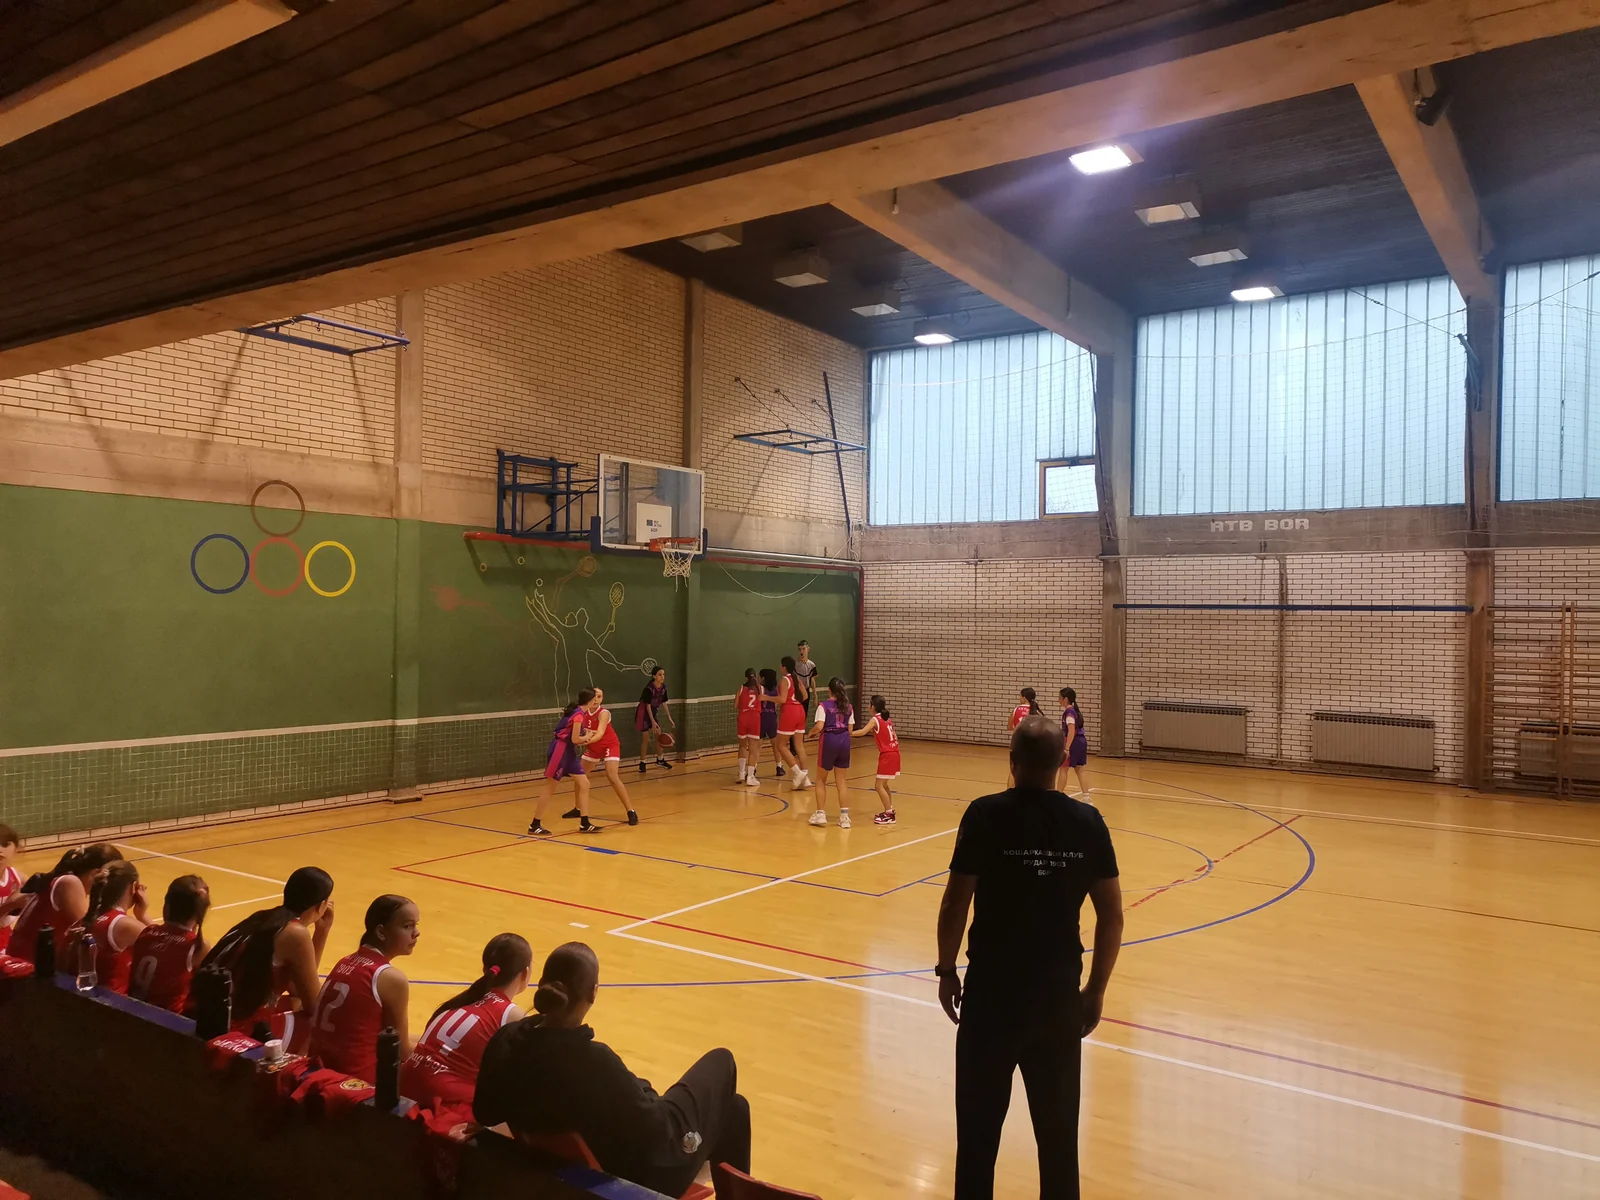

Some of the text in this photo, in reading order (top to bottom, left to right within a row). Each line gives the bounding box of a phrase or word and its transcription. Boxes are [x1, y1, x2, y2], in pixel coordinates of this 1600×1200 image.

[1264, 518, 1310, 531] BOR
[748, 694, 757, 708] 2
[1062, 851, 1084, 859] КЛУБ
[1049, 860, 1067, 868] 1903
[309, 979, 350, 1033] 12
[417, 1007, 480, 1056] 14
